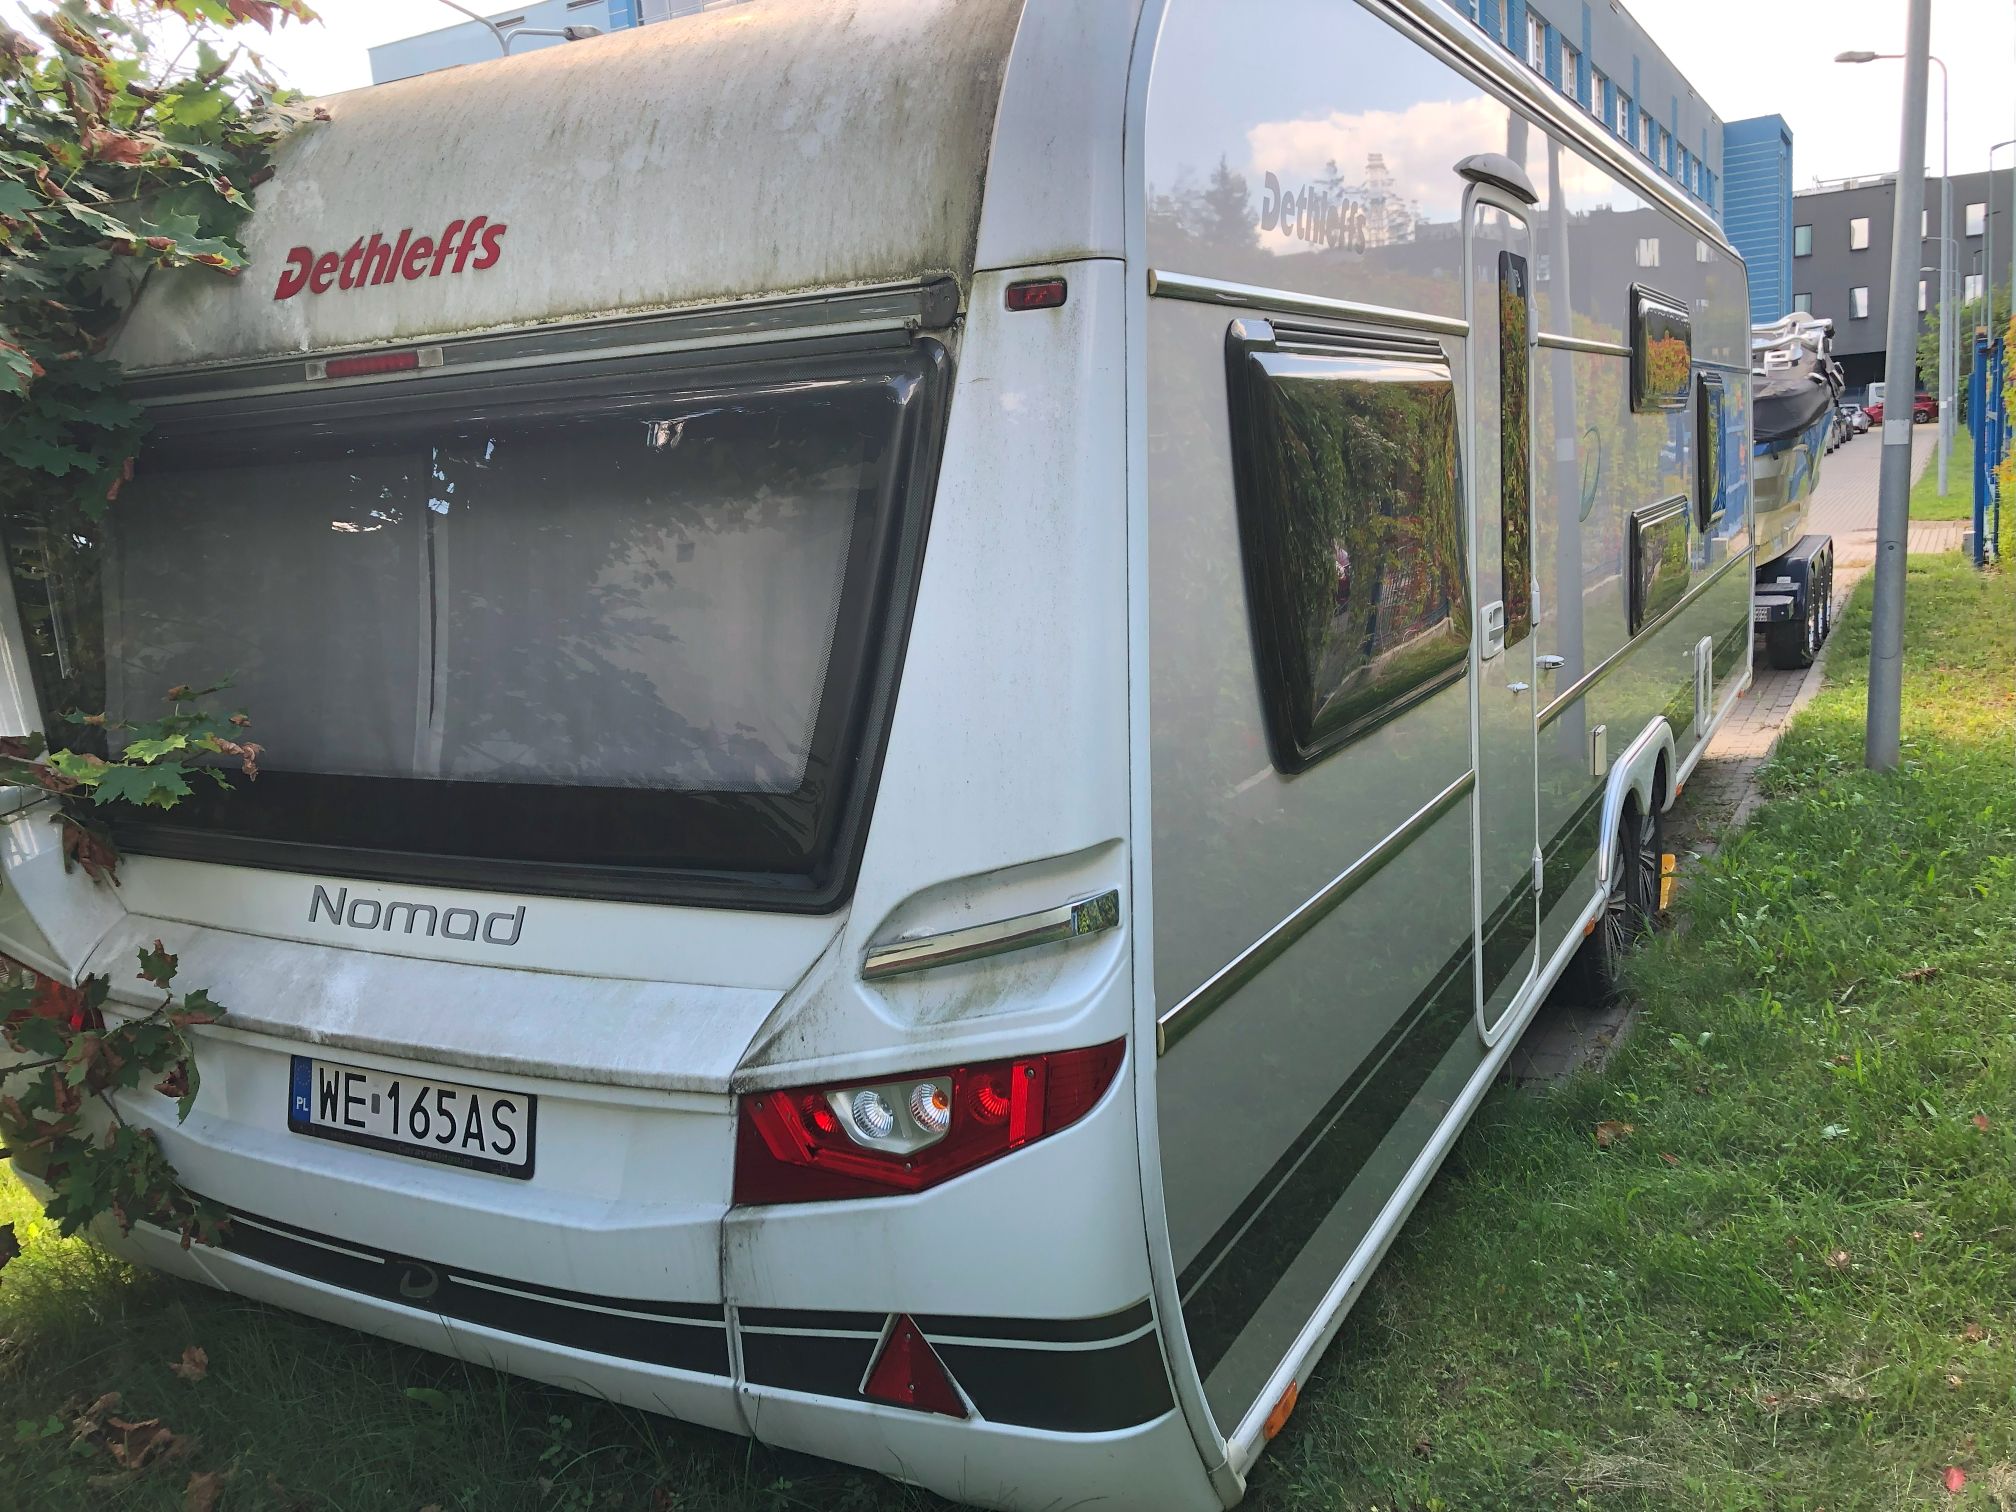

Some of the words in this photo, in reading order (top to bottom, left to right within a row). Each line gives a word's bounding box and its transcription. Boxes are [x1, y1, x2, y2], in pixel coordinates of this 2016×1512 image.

[1261, 170, 1366, 255] Dethleffs
[273, 215, 507, 300] Dethleffs
[308, 884, 527, 946] Nomad
[296, 1096, 309, 1112] PL
[319, 1067, 367, 1128] WE
[387, 1080, 517, 1156] 165AS
